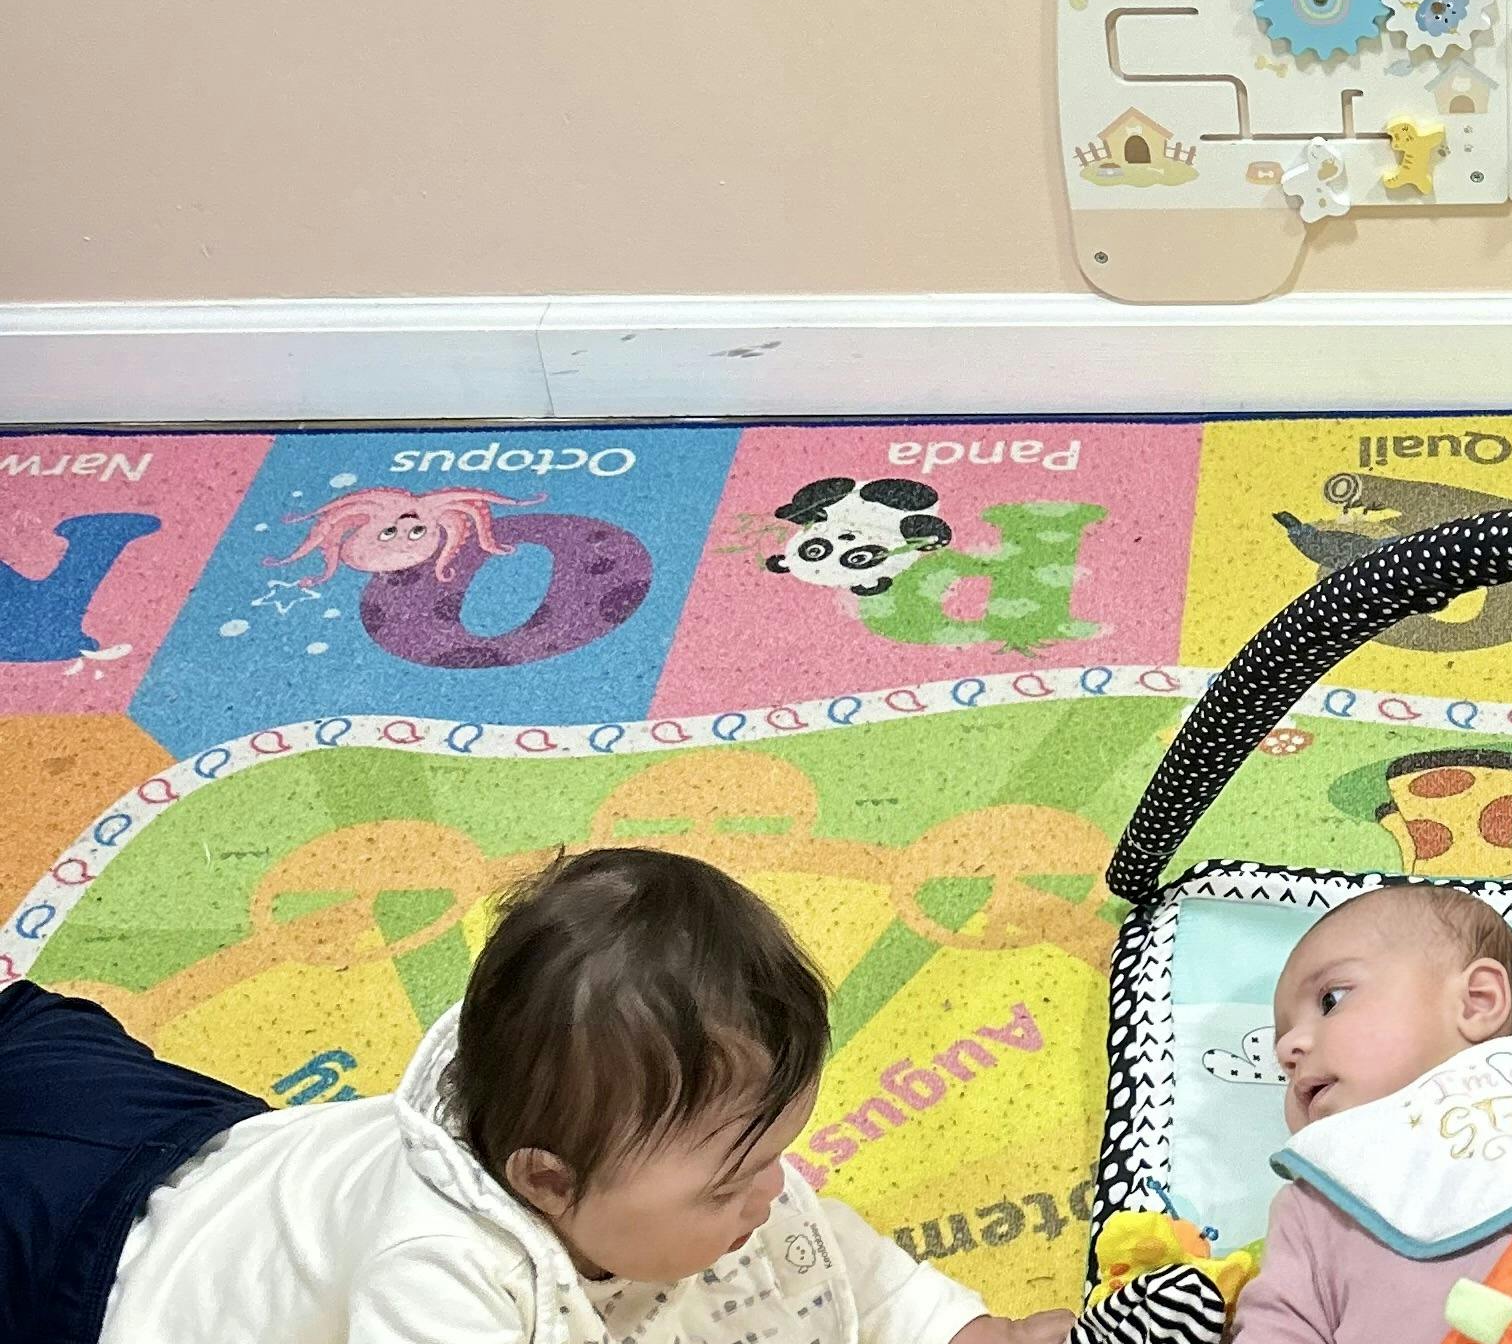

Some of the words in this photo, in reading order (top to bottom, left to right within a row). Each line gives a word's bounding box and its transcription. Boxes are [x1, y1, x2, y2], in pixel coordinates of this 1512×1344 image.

[389, 441, 638, 477] Octopus
[887, 438, 1083, 475] Panda
[784, 1002, 1044, 1191] August
